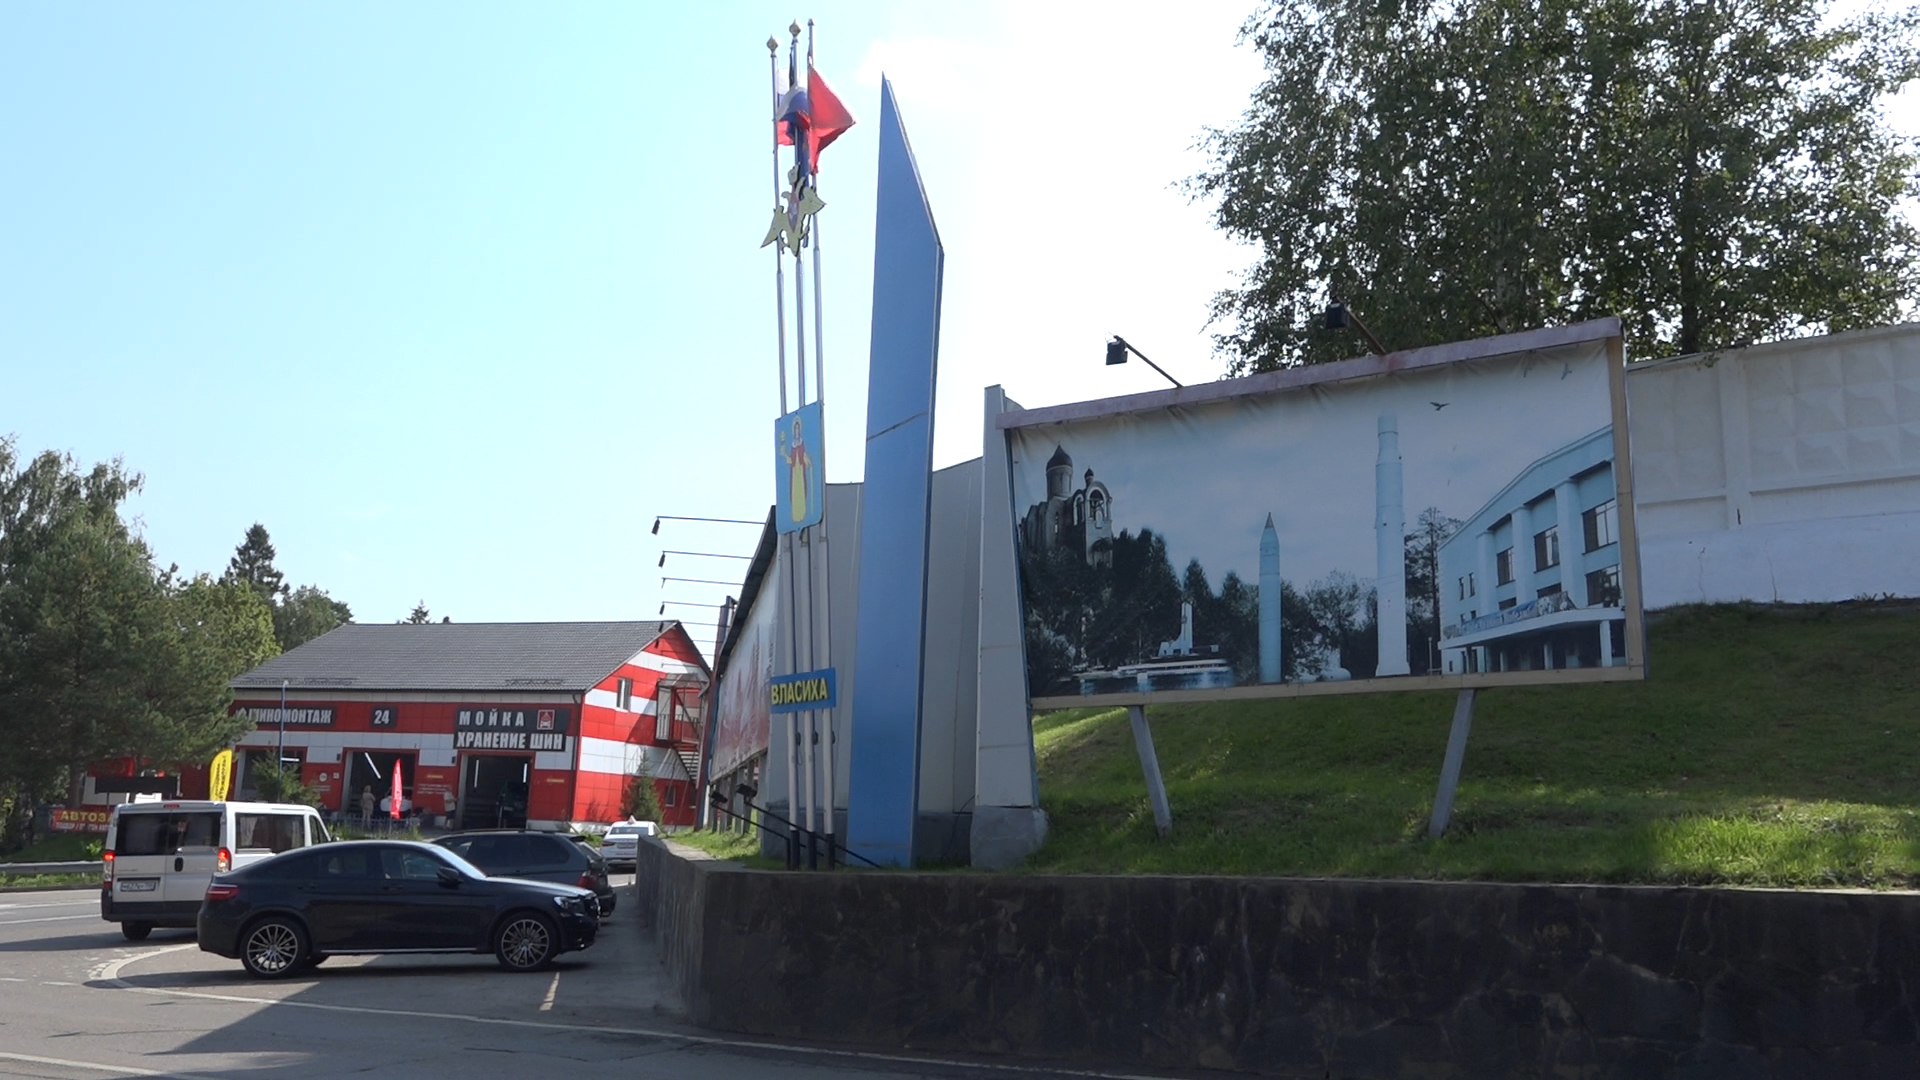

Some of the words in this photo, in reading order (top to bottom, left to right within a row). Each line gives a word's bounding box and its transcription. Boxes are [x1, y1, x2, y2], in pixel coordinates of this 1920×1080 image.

[771, 678, 828, 705] ВЛАСИХА
[373, 709, 390, 725] 24
[458, 708, 525, 727] МОЙКА
[456, 731, 526, 749] ХРАНЕНИЕ
[529, 733, 563, 750] ШИН
